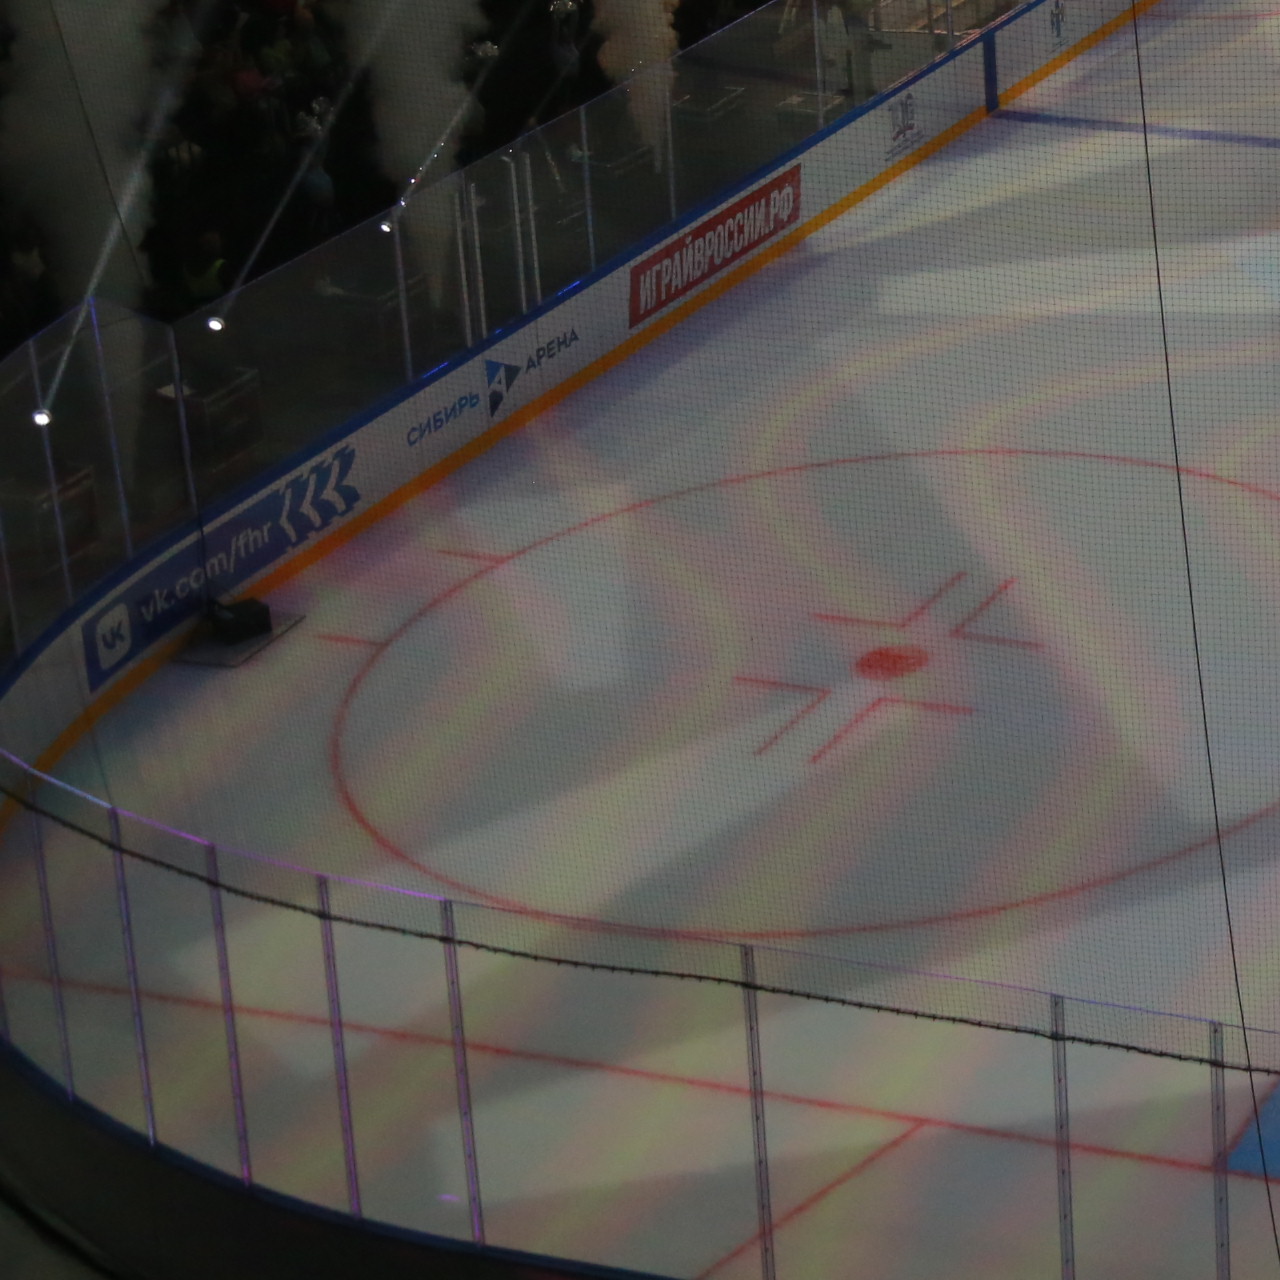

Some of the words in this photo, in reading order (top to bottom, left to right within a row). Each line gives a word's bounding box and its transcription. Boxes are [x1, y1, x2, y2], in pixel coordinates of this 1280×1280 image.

[638, 182, 795, 316] ИГРАЙВРОССИИ.РФ
[406, 392, 480, 448] СИБИРЬ
[524, 327, 580, 372] АРЕНА
